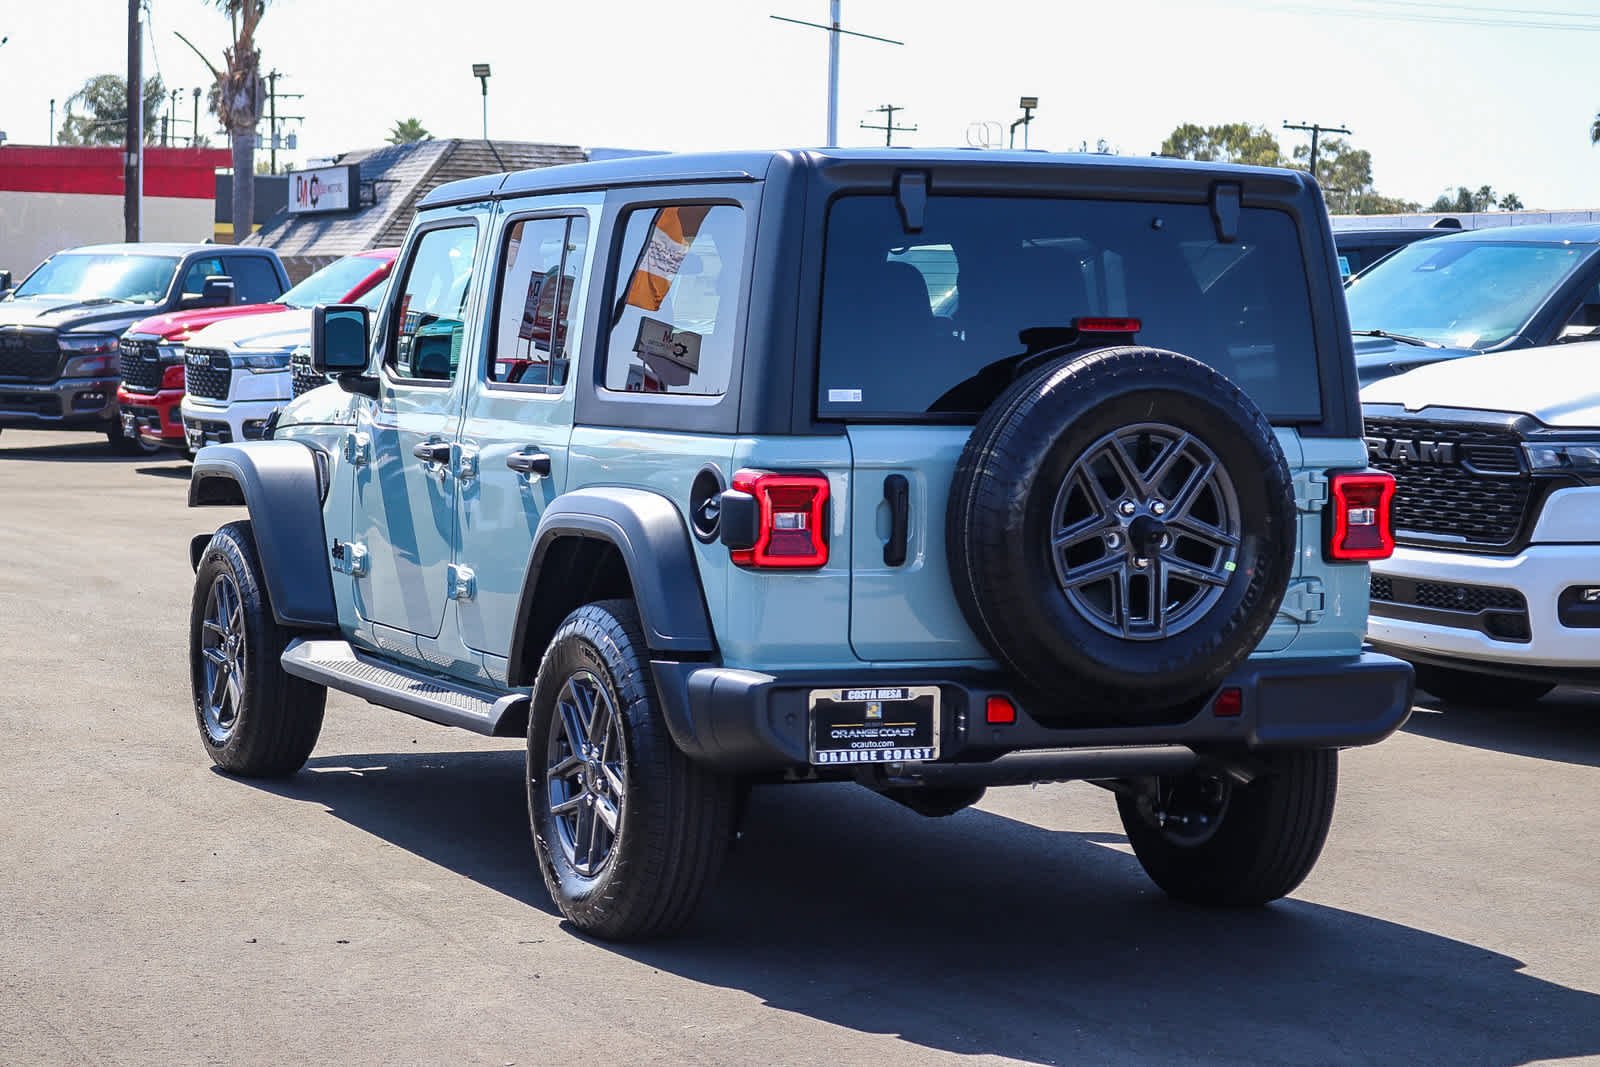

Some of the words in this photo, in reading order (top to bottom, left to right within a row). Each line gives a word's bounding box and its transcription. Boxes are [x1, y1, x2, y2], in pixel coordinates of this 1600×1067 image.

[185, 353, 210, 366] RAM
[1362, 437, 1454, 464] RAM
[848, 690, 877, 700] COSTA
[878, 689, 902, 699] MESA
[831, 729, 879, 738] ORANGE
[880, 728, 917, 737] COAST
[819, 751, 877, 763] ORANGE
[883, 748, 931, 760] COAST
